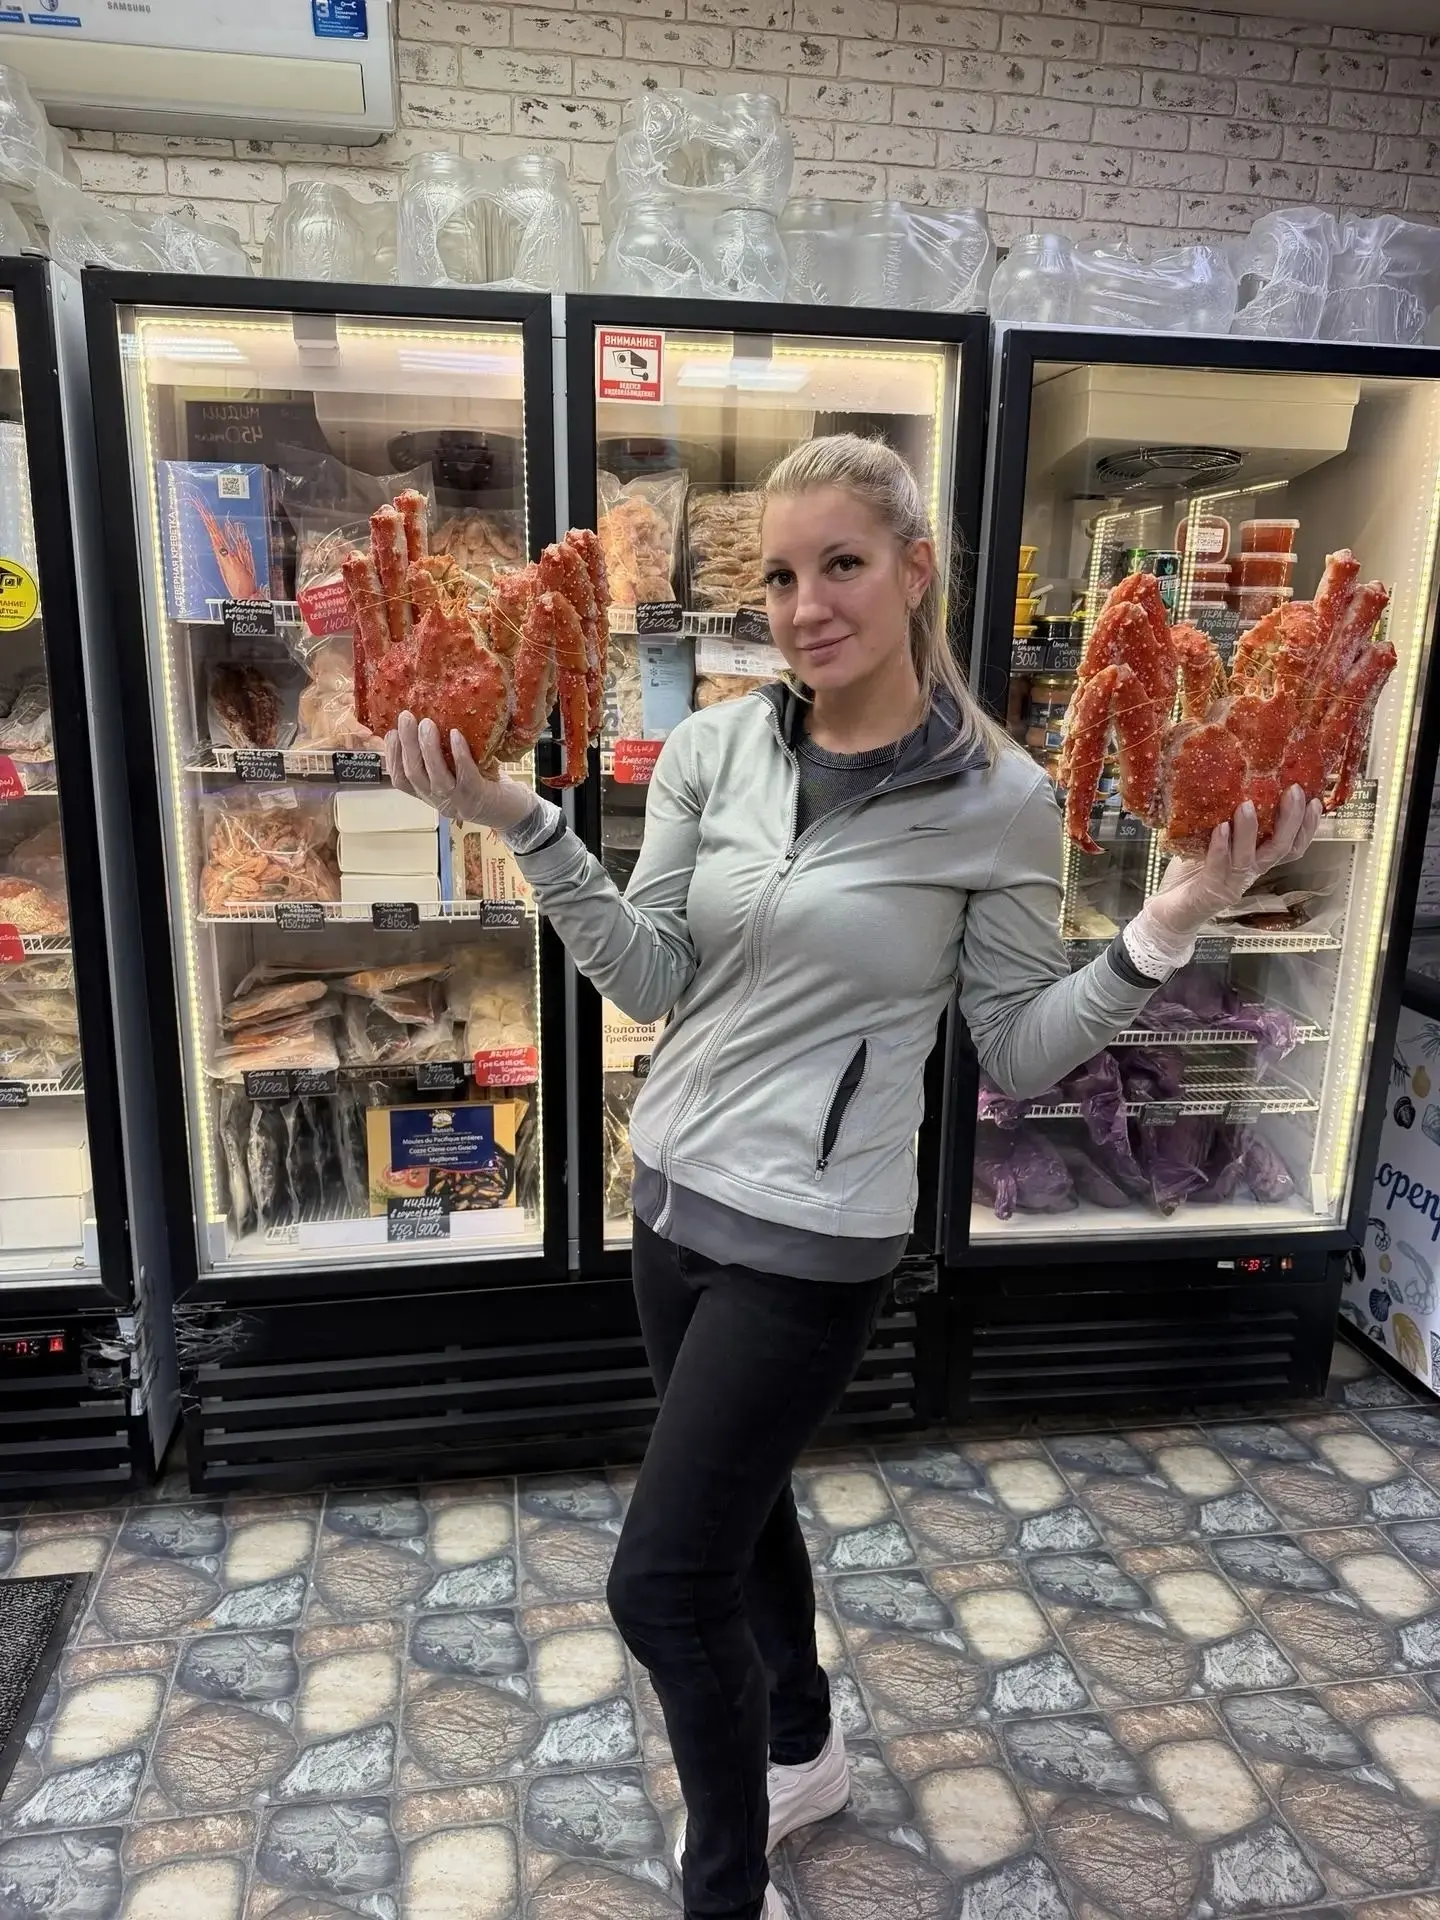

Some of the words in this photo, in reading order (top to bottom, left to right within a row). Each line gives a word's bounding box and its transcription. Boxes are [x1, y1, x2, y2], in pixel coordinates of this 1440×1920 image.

[107, 2, 151, 13] SAMSUNG
[604, 335, 657, 347] ВНИМАНИЕ!
[168, 511, 180, 555] КРЕВЕТКА
[604, 1023, 656, 1034] Золотой
[605, 1035, 655, 1043] Гребешок
[433, 1135, 460, 1143] Pacifique
